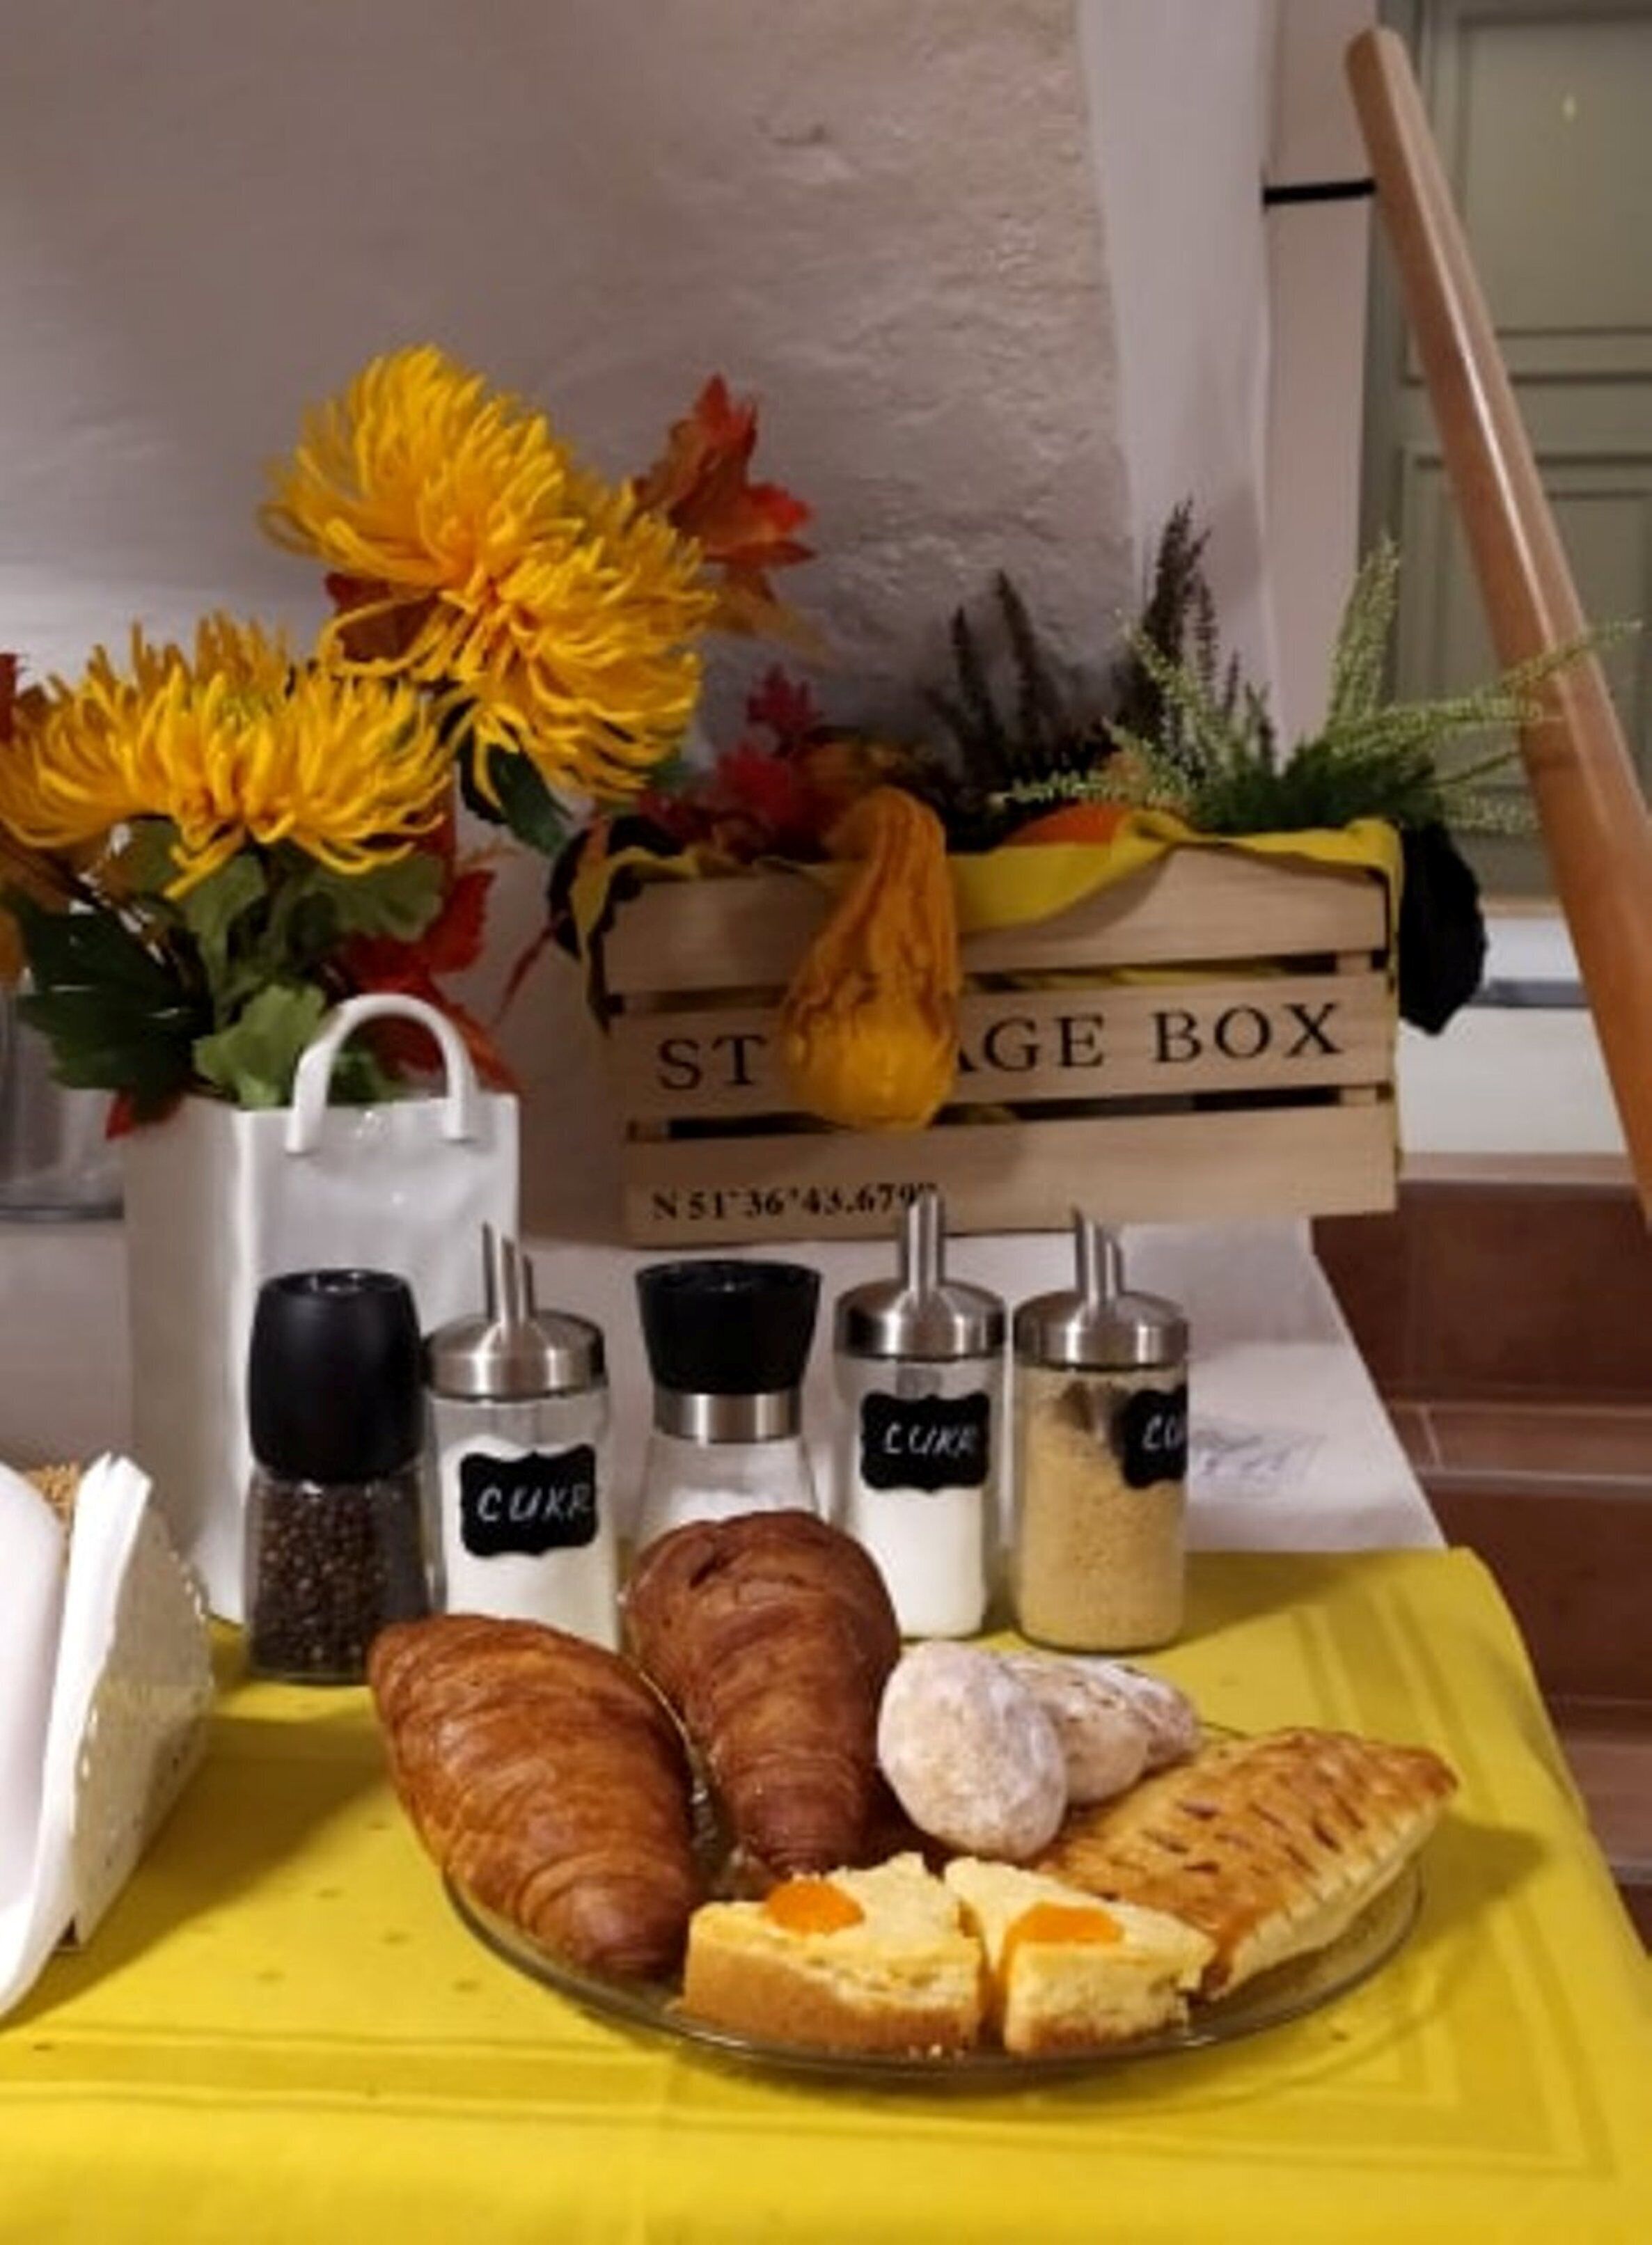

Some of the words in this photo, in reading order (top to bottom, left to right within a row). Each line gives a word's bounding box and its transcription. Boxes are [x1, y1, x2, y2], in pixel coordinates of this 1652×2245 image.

[658, 1012, 1105, 1090] STGE
[1153, 1002, 1344, 1064] BOX
[652, 1191, 678, 1220] N
[476, 1483, 592, 1522] CUKR
